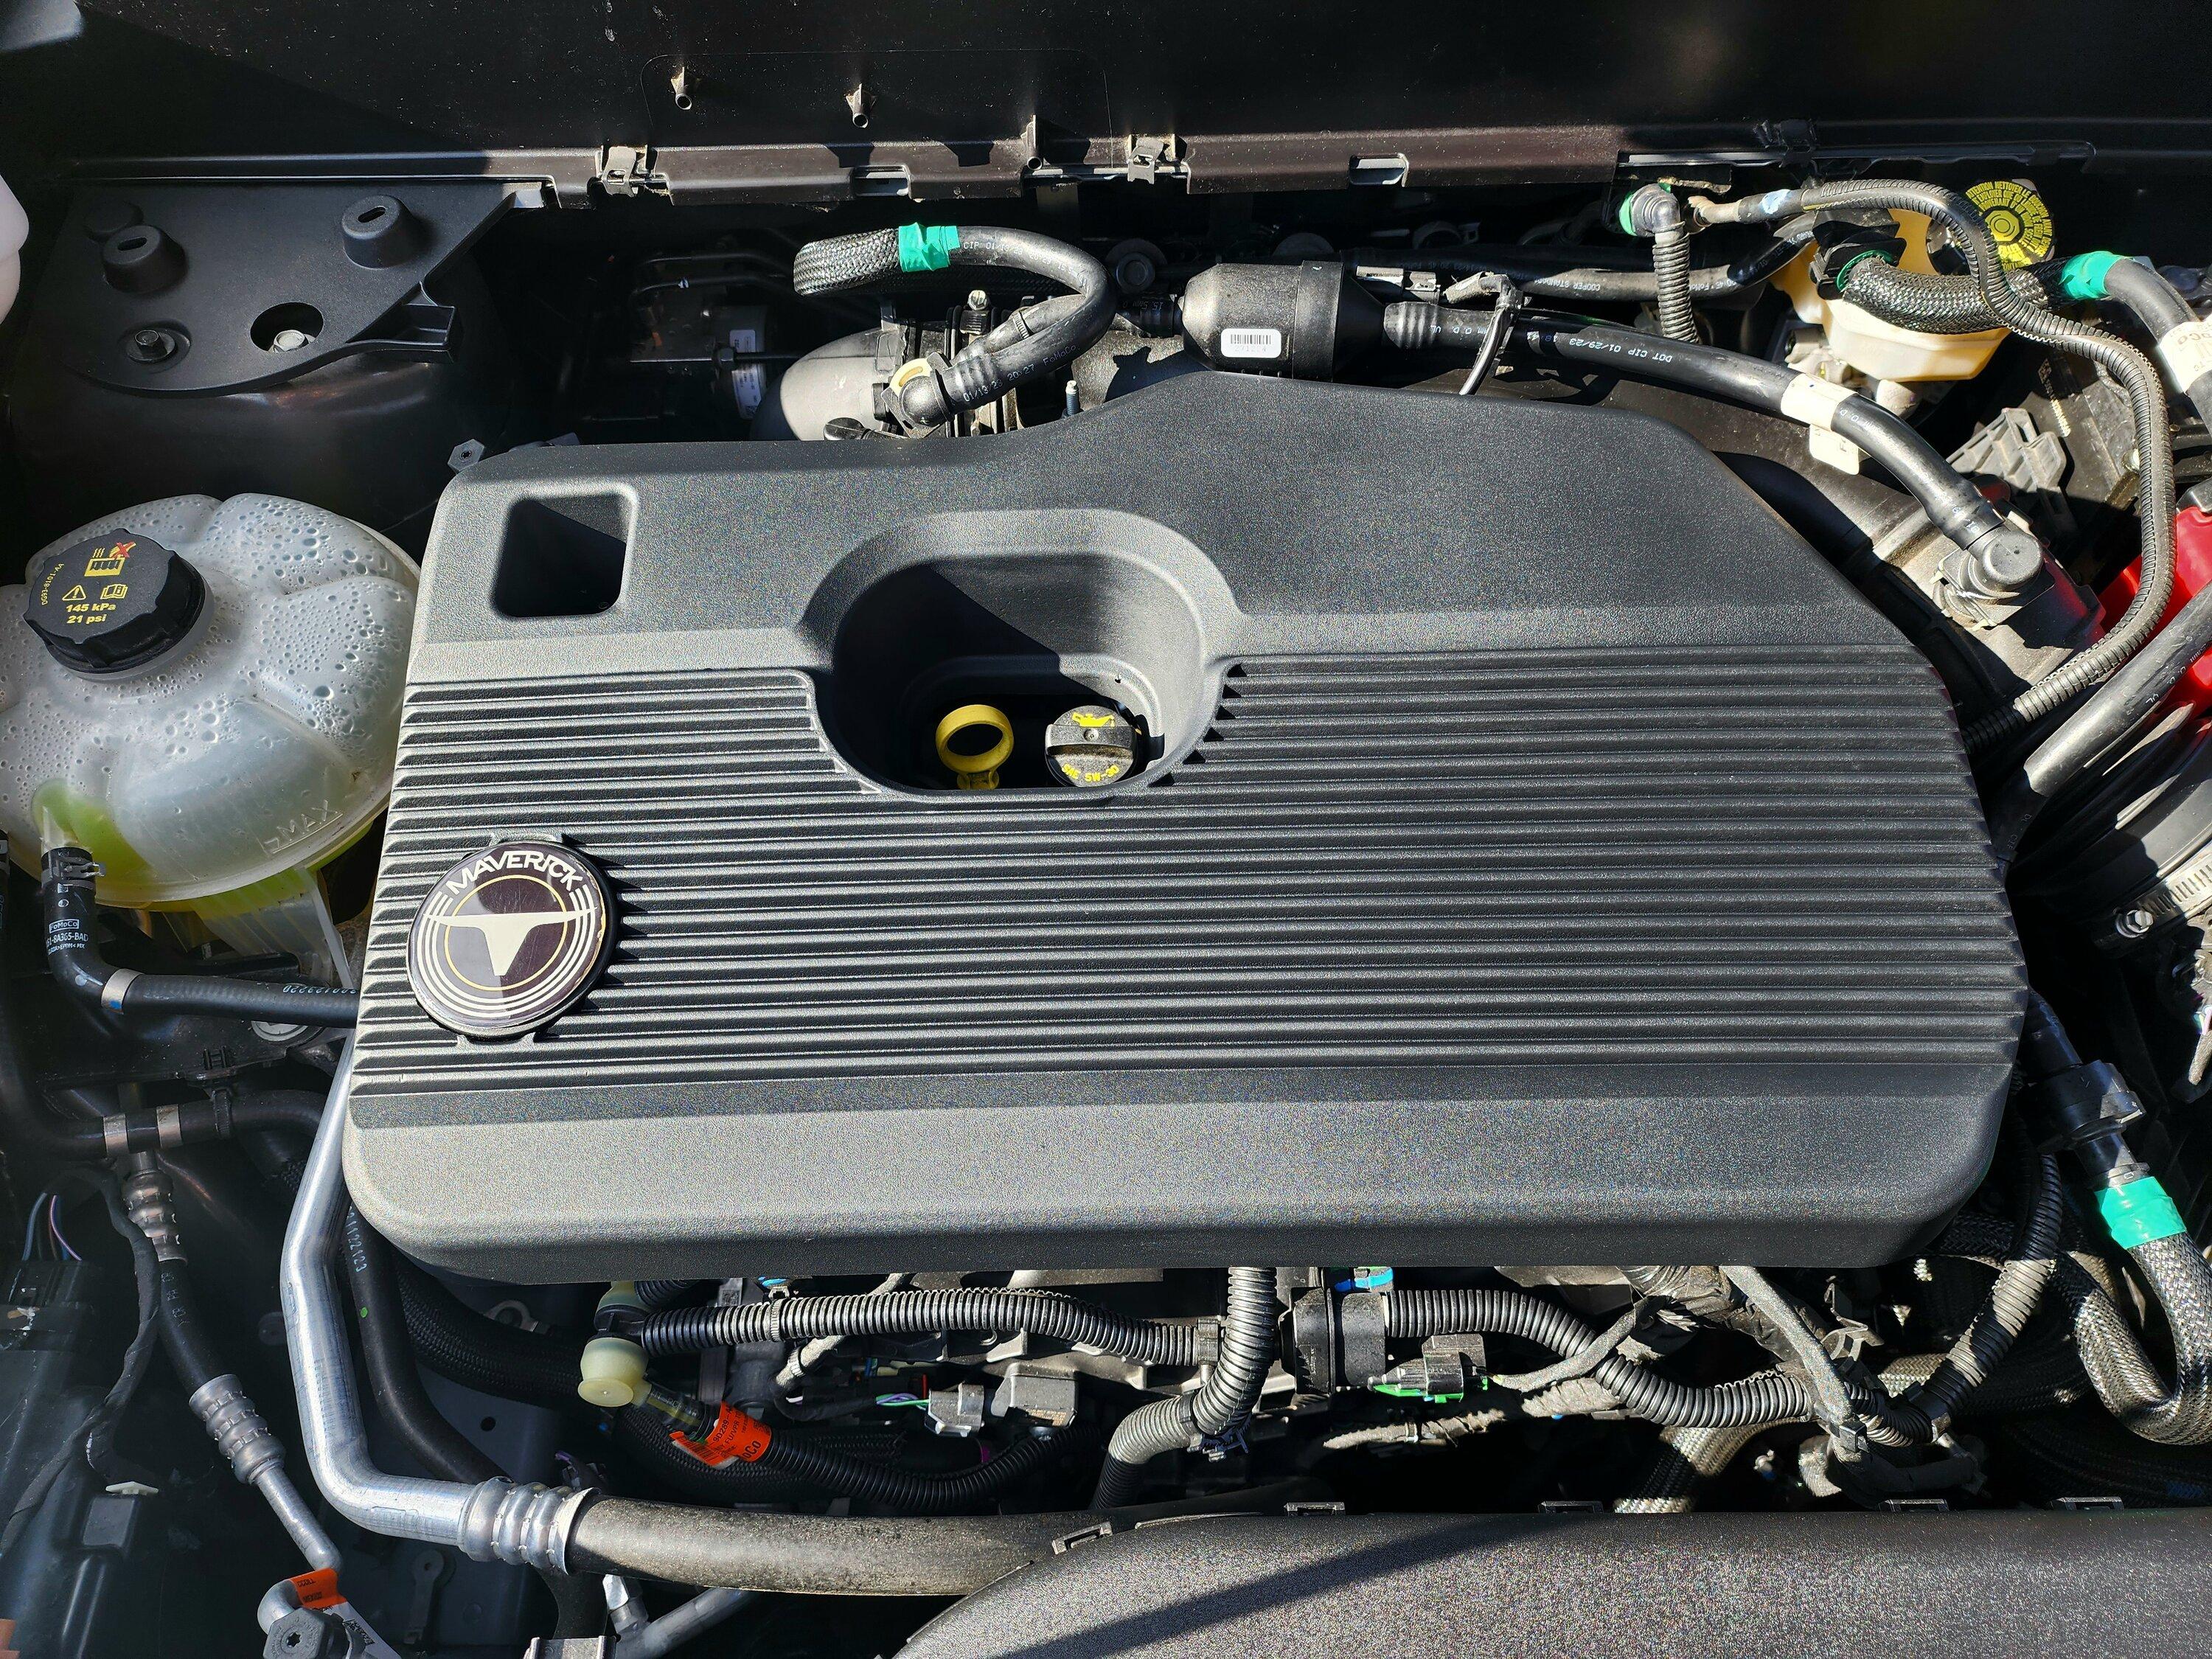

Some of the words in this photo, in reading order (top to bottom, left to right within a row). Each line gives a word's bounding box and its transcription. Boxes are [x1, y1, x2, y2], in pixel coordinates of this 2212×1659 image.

[1573, 282, 1601, 292] COOPER
[1569, 338, 1621, 352] 01/29/23
[1627, 347, 1648, 358] CIP
[1652, 353, 1673, 363] DOT
[91, 603, 116, 611] kPa
[66, 616, 83, 624] 21
[86, 614, 107, 625] psi
[1062, 763, 1081, 780] SAE
[276, 799, 338, 841] MAX
[445, 850, 583, 895] MAVERICK
[50, 919, 79, 933] FoMoCo
